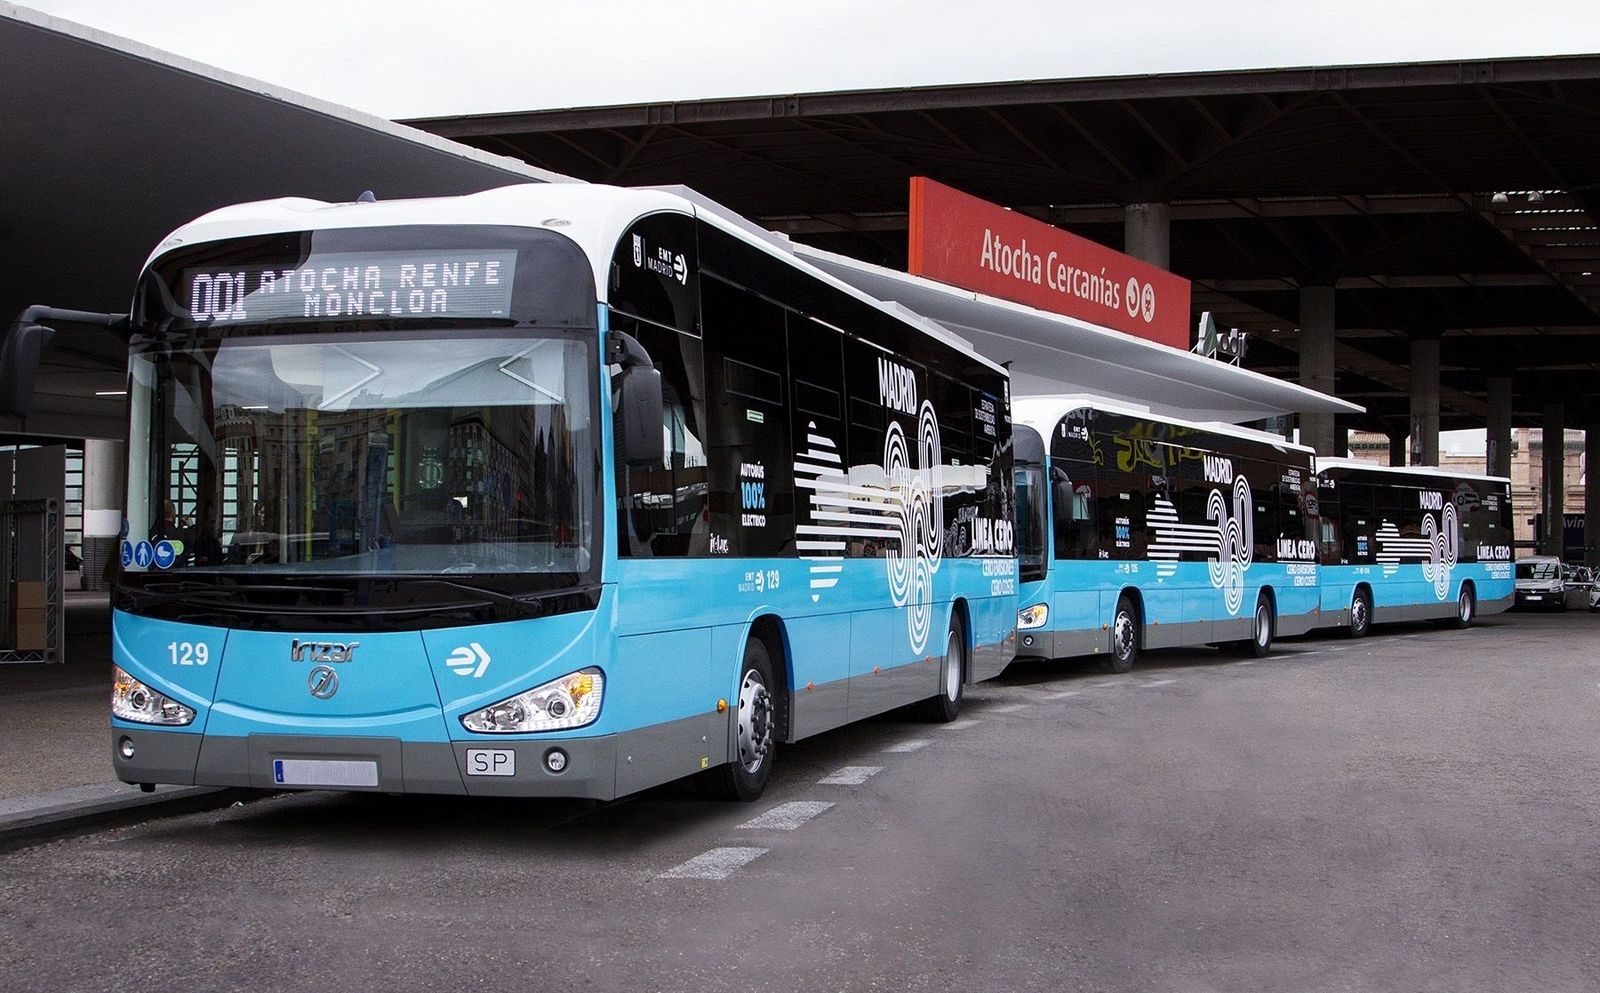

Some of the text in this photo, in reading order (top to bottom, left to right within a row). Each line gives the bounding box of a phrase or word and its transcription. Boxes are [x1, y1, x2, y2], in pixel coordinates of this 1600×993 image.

[647, 256, 673, 278] MADRID
[658, 247, 672, 263] EMT
[980, 228, 1120, 310] Atocha Cercanías
[259, 260, 501, 293] ATOCHA RENFE
[190, 271, 248, 321] 001
[304, 288, 448, 318] MONCLOA
[877, 356, 918, 416] MADRID
[740, 460, 765, 479] AUTOBÚS
[1203, 454, 1233, 485] MADRID
[741, 481, 766, 510] 100%
[1419, 490, 1443, 510] MADRID
[994, 518, 1014, 551] CERO
[1276, 532, 1316, 560] LÍNEA CERO
[1476, 541, 1511, 560] LÍNEA CERO
[767, 569, 780, 589] 129
[168, 641, 209, 667] 129
[474, 752, 508, 773] SP
